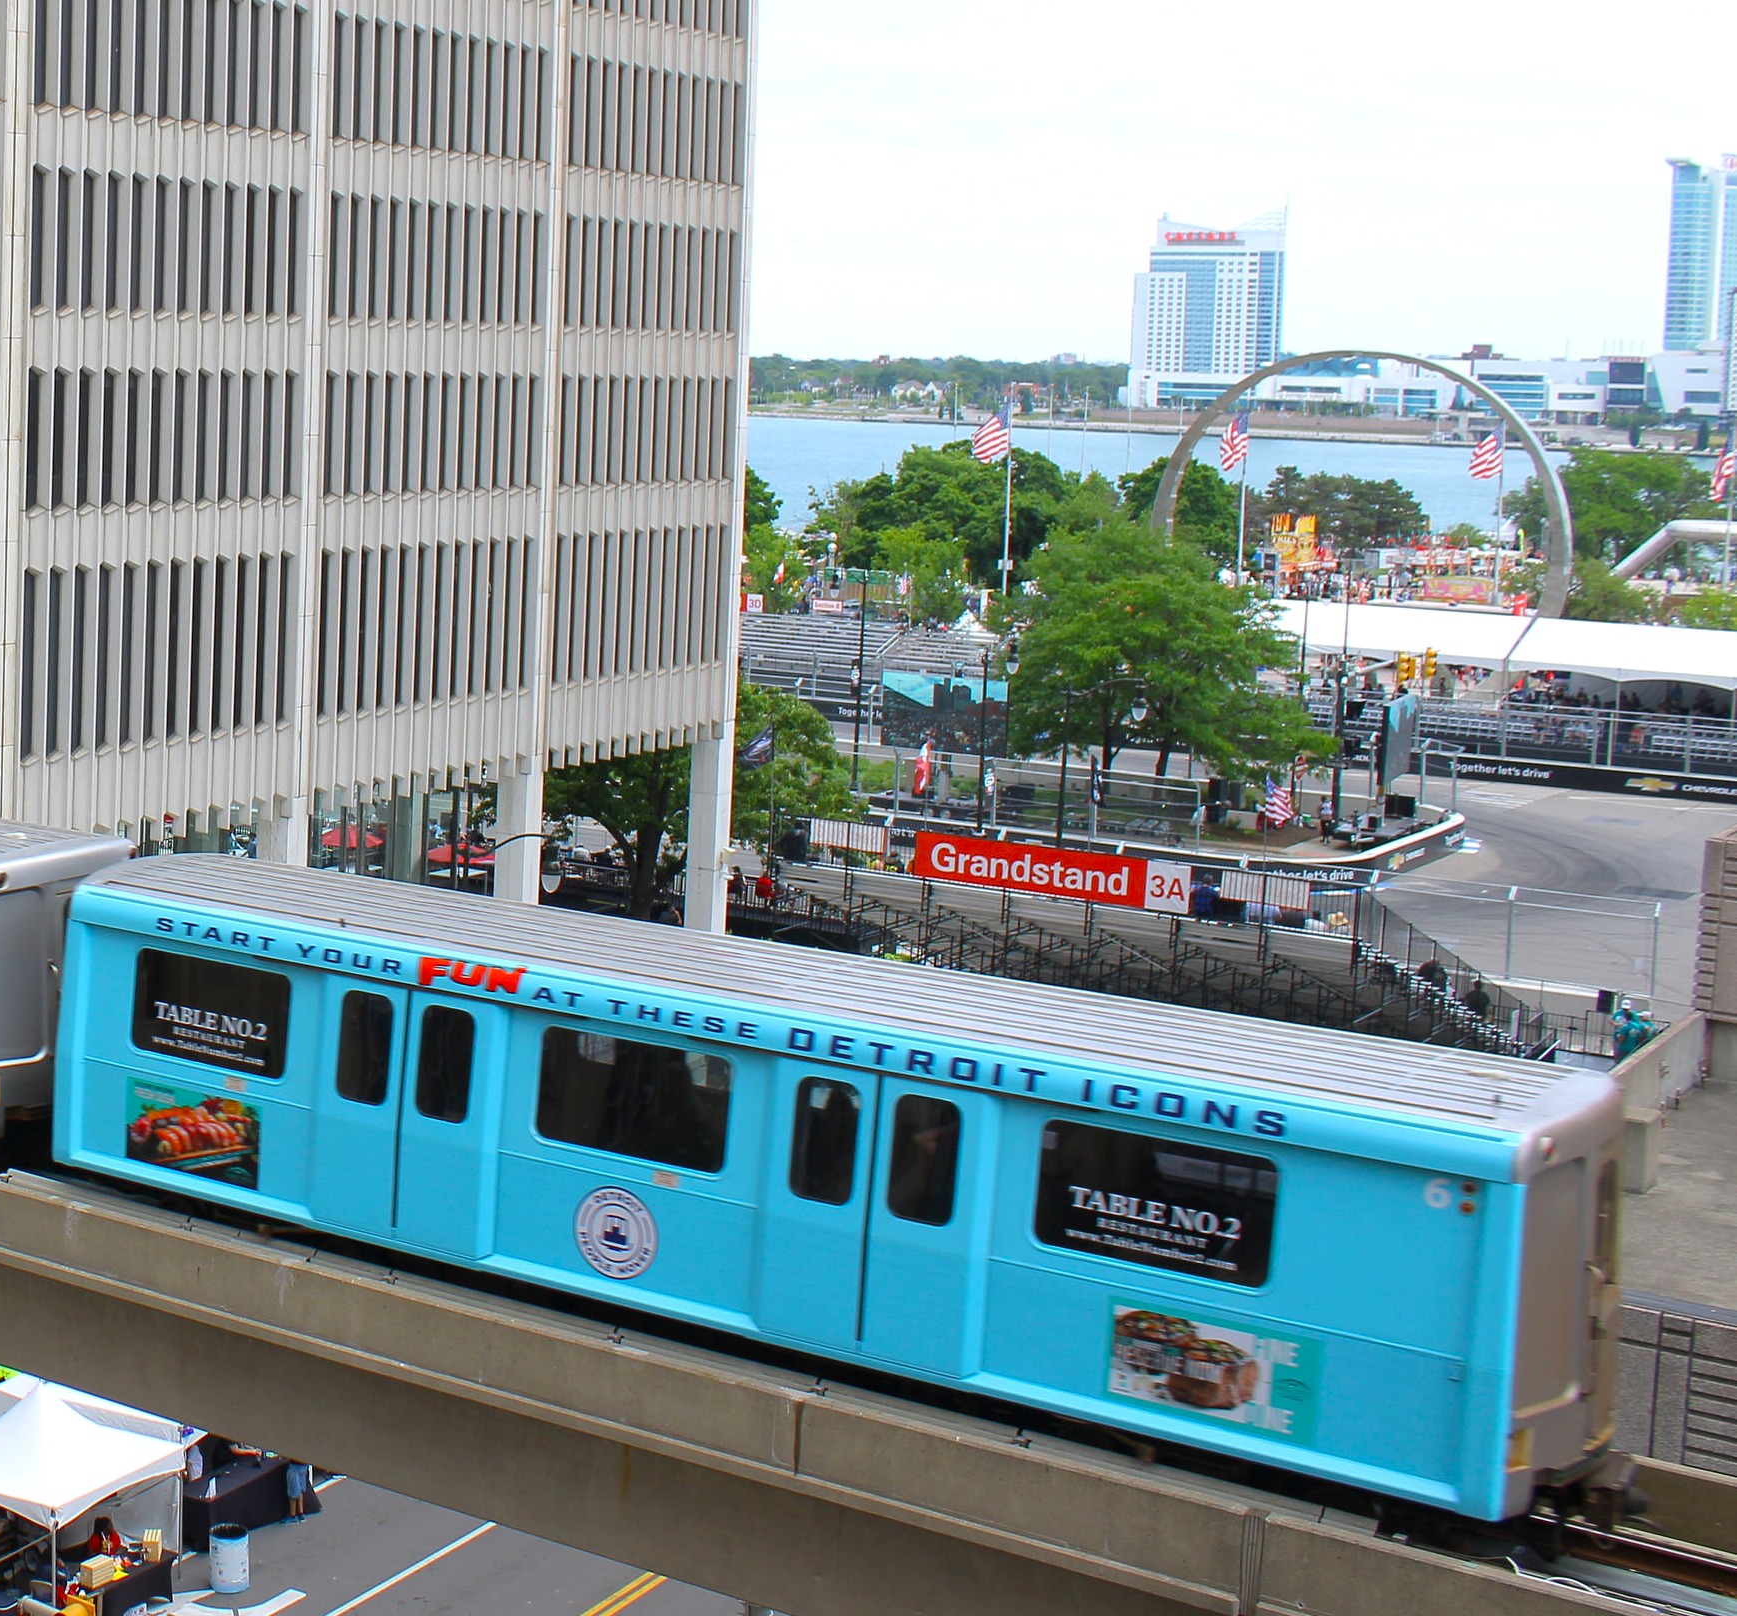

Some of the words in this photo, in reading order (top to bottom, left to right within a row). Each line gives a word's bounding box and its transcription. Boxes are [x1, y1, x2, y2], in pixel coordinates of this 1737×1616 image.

[748, 599, 761, 608] 3D
[1497, 765, 1521, 777] let's
[1521, 767, 1551, 779] drive
[930, 842, 1129, 896] Grandstand
[1149, 874, 1184, 902] 3A
[1329, 868, 1354, 881] drive
[154, 1001, 219, 1031] TABLE
[220, 1014, 268, 1041] NO.2
[155, 917, 276, 952] START
[296, 942, 402, 975] YOUR
[418, 956, 529, 994] FUN
[532, 986, 584, 1007] AT
[606, 998, 760, 1040] THESE
[787, 1027, 1047, 1093] DETROIT
[1081, 1079, 1286, 1138] ICONS
[172, 1026, 247, 1050] RESTAURANT
[594, 1191, 643, 1212] DETROIT
[1425, 1177, 1451, 1209] 6
[1068, 1185, 1167, 1225] TABLE
[1169, 1205, 1242, 1240] NO.2
[1096, 1217, 1209, 1249] RESTAURANT
